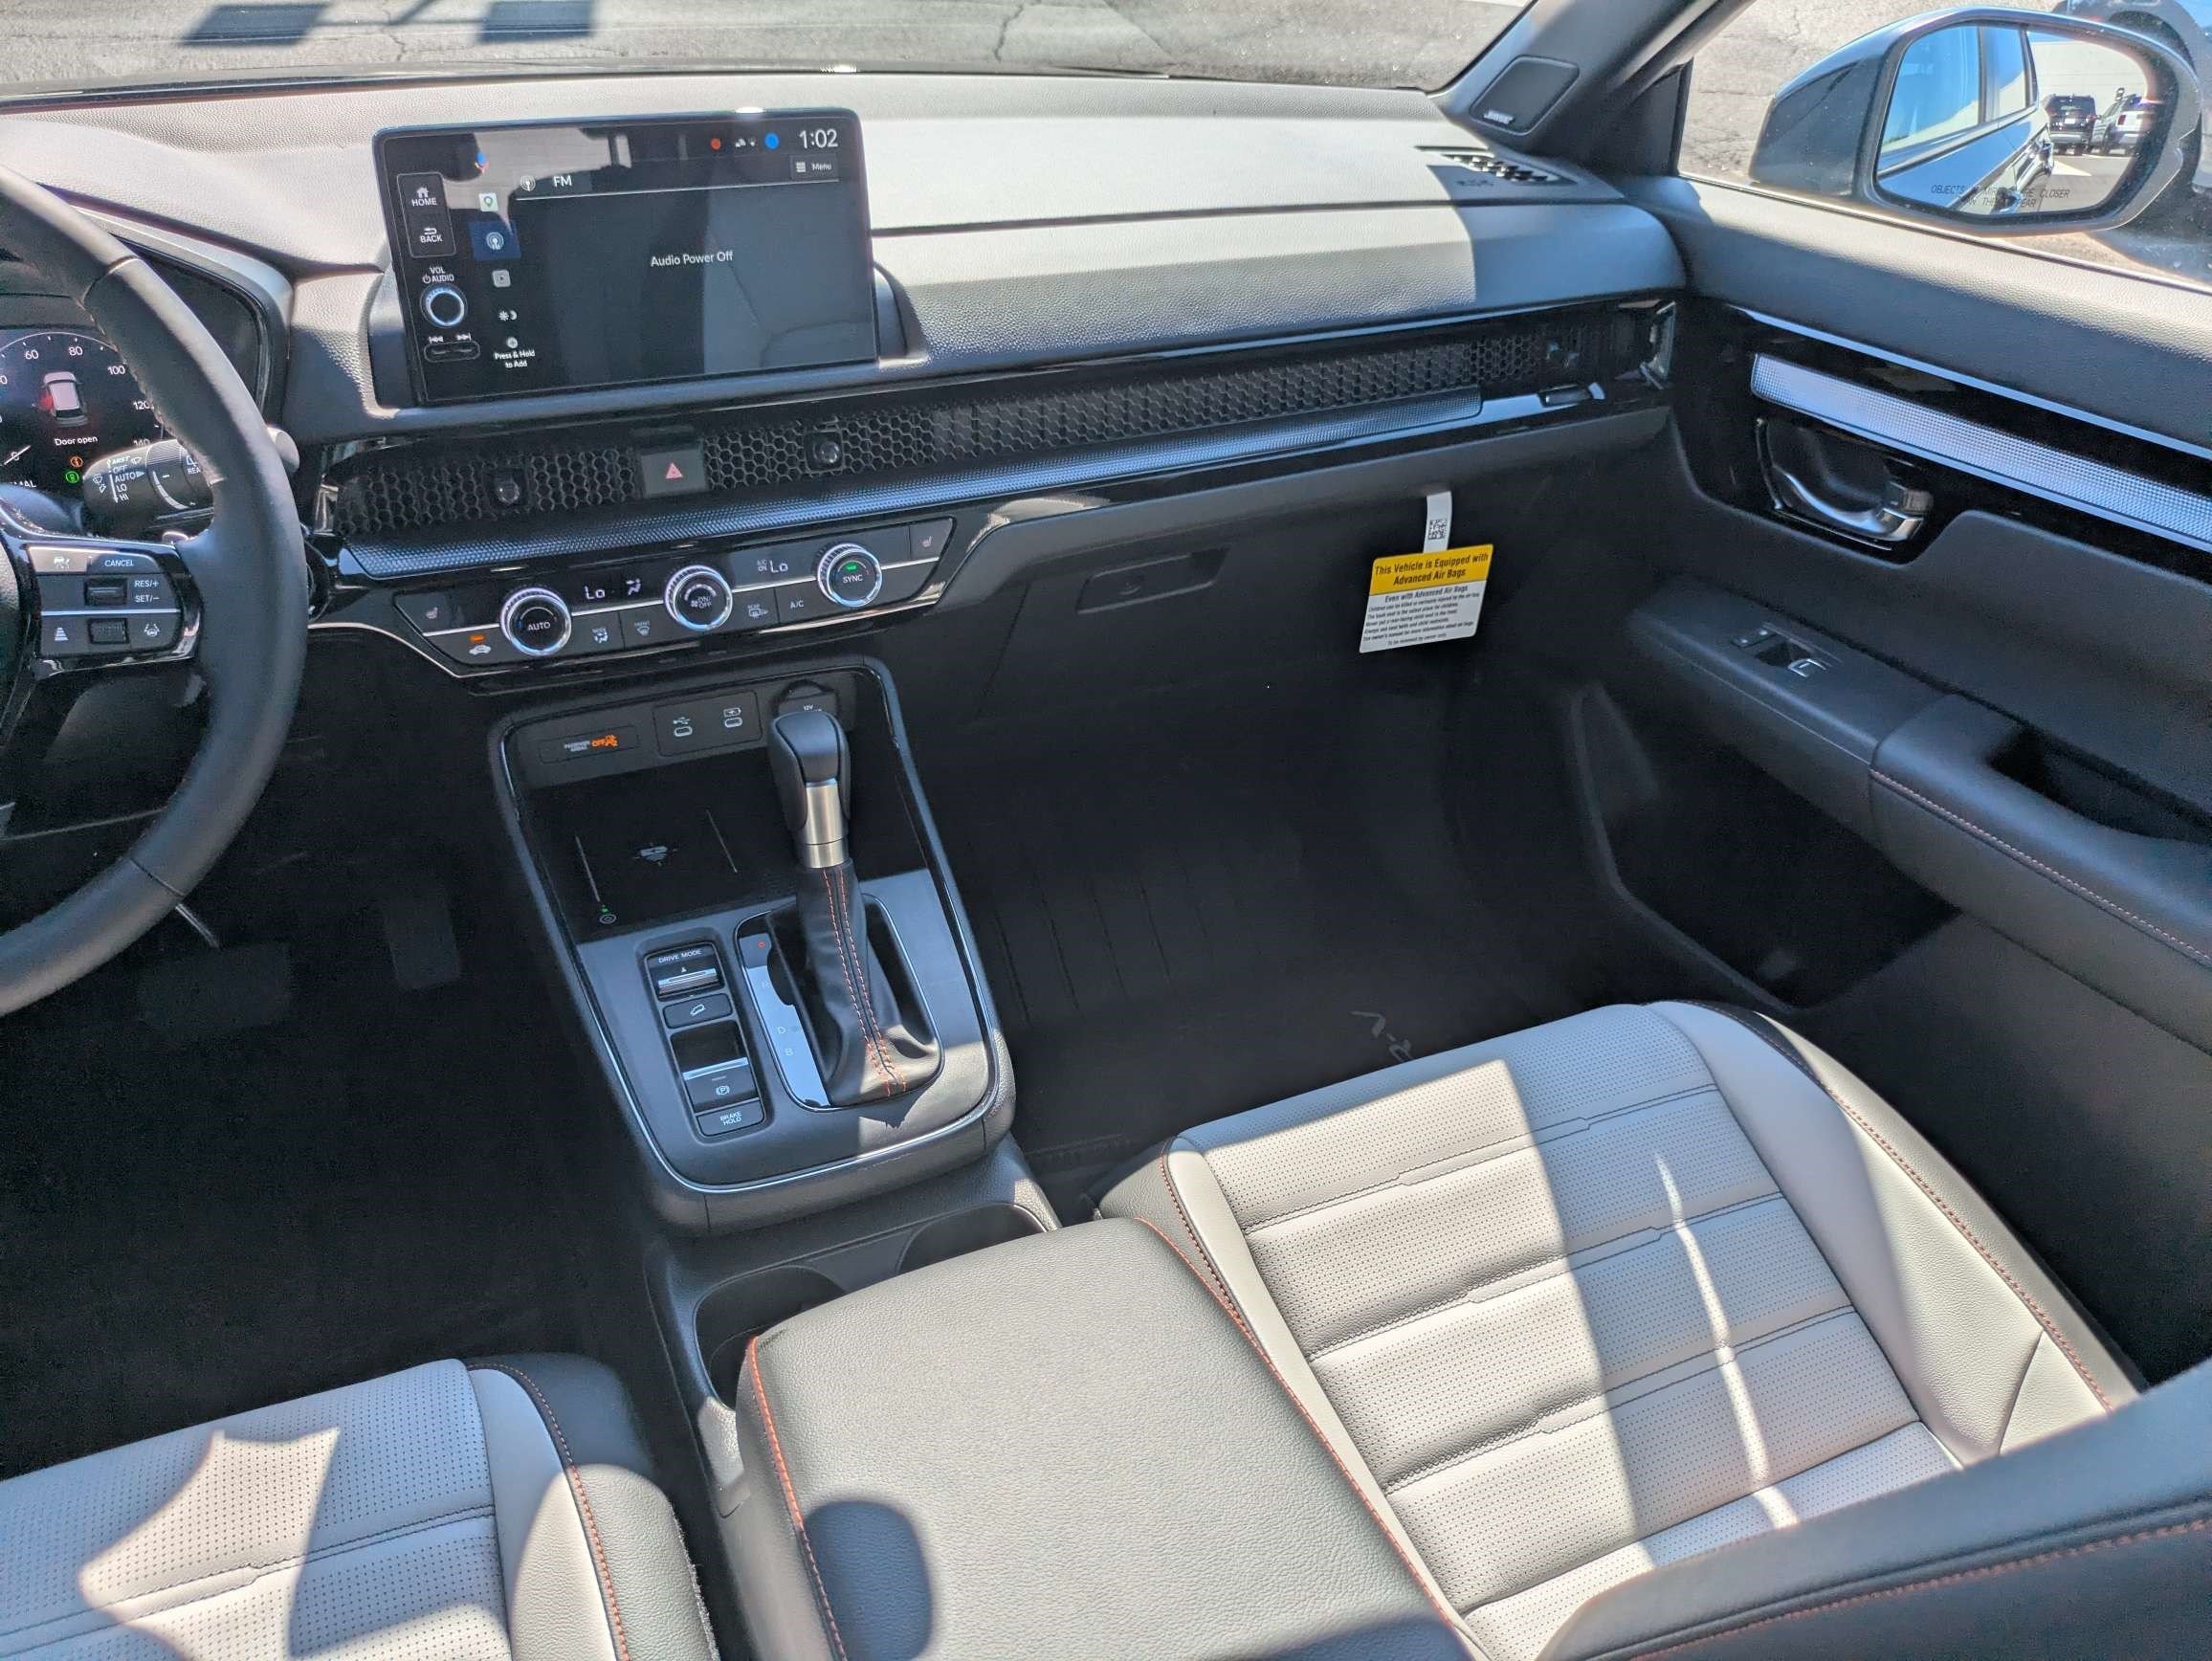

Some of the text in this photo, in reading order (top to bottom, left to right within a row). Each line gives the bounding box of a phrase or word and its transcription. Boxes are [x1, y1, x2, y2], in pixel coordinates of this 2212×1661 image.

[799, 128, 839, 149] 1:02
[812, 163, 832, 171] Menu
[553, 176, 572, 187] FM
[411, 197, 437, 207] HOME
[420, 234, 443, 243] BACK
[651, 250, 734, 268] Audio Power Off
[430, 266, 446, 275] VOL
[431, 274, 454, 283] AUDIO
[24, 349, 39, 360] 60
[68, 345, 83, 357] 80
[107, 365, 126, 375] 100
[54, 436, 99, 447] Door open
[113, 464, 128, 474] OFF
[115, 472, 136, 482] AUTO
[117, 483, 127, 492] LO
[104, 559, 134, 567] CANCEL
[769, 560, 788, 573] Lo
[1375, 552, 1489, 576] This Vehicle is Equipped with
[842, 574, 864, 584] SYNC
[1393, 567, 1467, 586] Advanced Air Bags
[585, 585, 606, 600] Lo
[1384, 594, 1400, 603] Even
[1401, 591, 1413, 600] with
[1415, 588, 1443, 598] Advanced
[789, 600, 805, 610] A/C
[527, 621, 551, 631] AUTO
[658, 948, 703, 963] DRIVE MODE
[719, 1110, 742, 1121] BRAKE
[722, 1117, 742, 1126] HOLD
